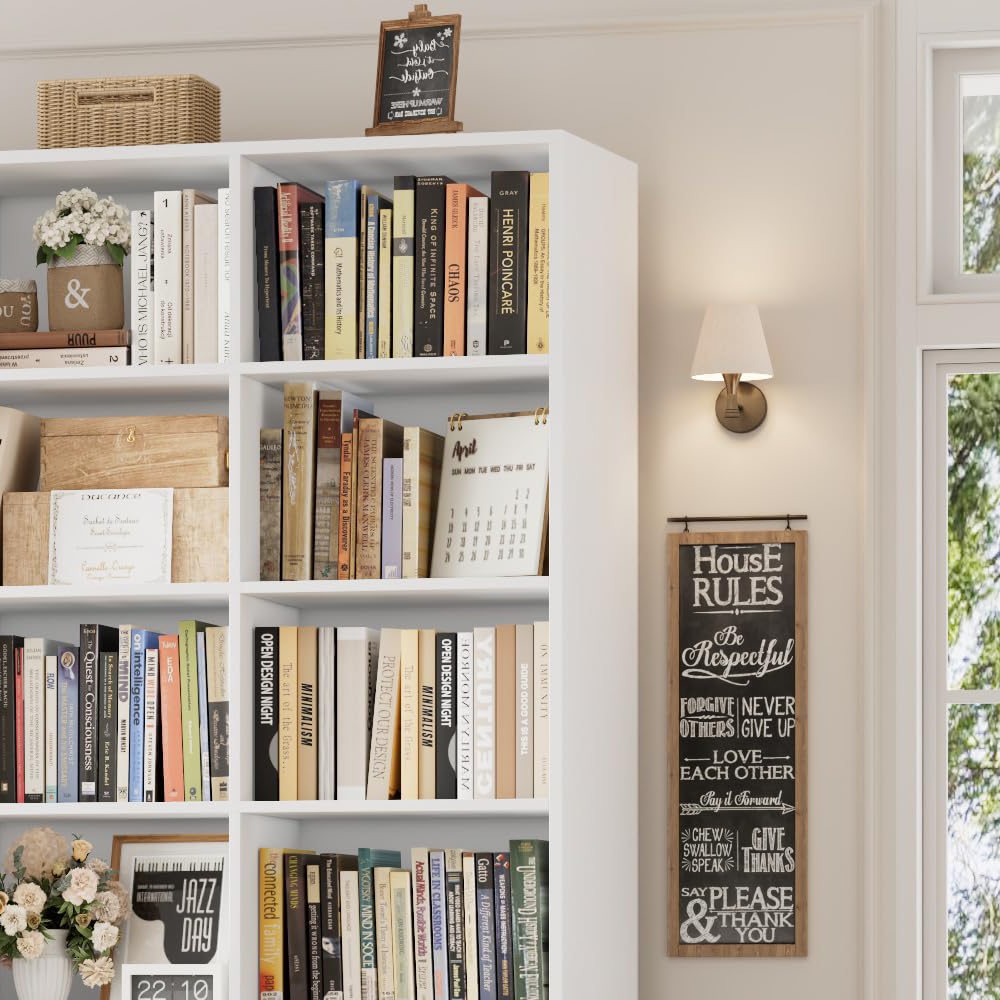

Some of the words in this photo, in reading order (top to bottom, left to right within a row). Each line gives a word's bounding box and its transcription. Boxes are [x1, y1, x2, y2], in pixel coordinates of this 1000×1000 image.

[502, 208, 514, 246] HENRI
[64, 278, 91, 309] &
[448, 264, 460, 303] CHAOS
[501, 250, 515, 315] POINCARÉ
[67, 332, 97, 345] PUUR
[451, 439, 477, 462] April
[692, 576, 784, 607] RULES
[133, 634, 142, 650] on
[260, 633, 273, 659] OPEN
[714, 625, 744, 646] Be
[85, 651, 96, 683] Quest
[681, 639, 795, 678] Respectful
[131, 652, 143, 726] intelligence
[260, 661, 273, 695] DESIGN
[260, 697, 273, 725] NIGHT
[680, 697, 735, 717] FORGIVE
[741, 696, 795, 716] NEVER
[84, 692, 95, 771] Consciousness
[680, 718, 735, 738] OTHERS
[741, 718, 774, 738] GIVE
[777, 718, 795, 737] UP
[712, 750, 762, 764] LOVE
[680, 766, 730, 781] EACH
[735, 765, 795, 779] OTHER
[700, 791, 721, 812] Pay
[723, 791, 733, 806] it
[734, 790, 783, 806] Forward
[692, 828, 724, 842] CHEW
[751, 827, 785, 851] GIVE
[683, 843, 733, 857] SWALLOW
[741, 847, 795, 873] THANKS
[478, 858, 489, 882] Gatto
[691, 858, 724, 873] SPEAK
[176, 878, 217, 914] JAZZ
[264, 863, 280, 919] connected
[681, 887, 709, 897] SAY
[709, 886, 794, 910] PLEASE
[680, 898, 721, 944] &
[717, 912, 794, 928] THANK
[735, 928, 776, 943] YOU
[137, 980, 167, 1000] 22
